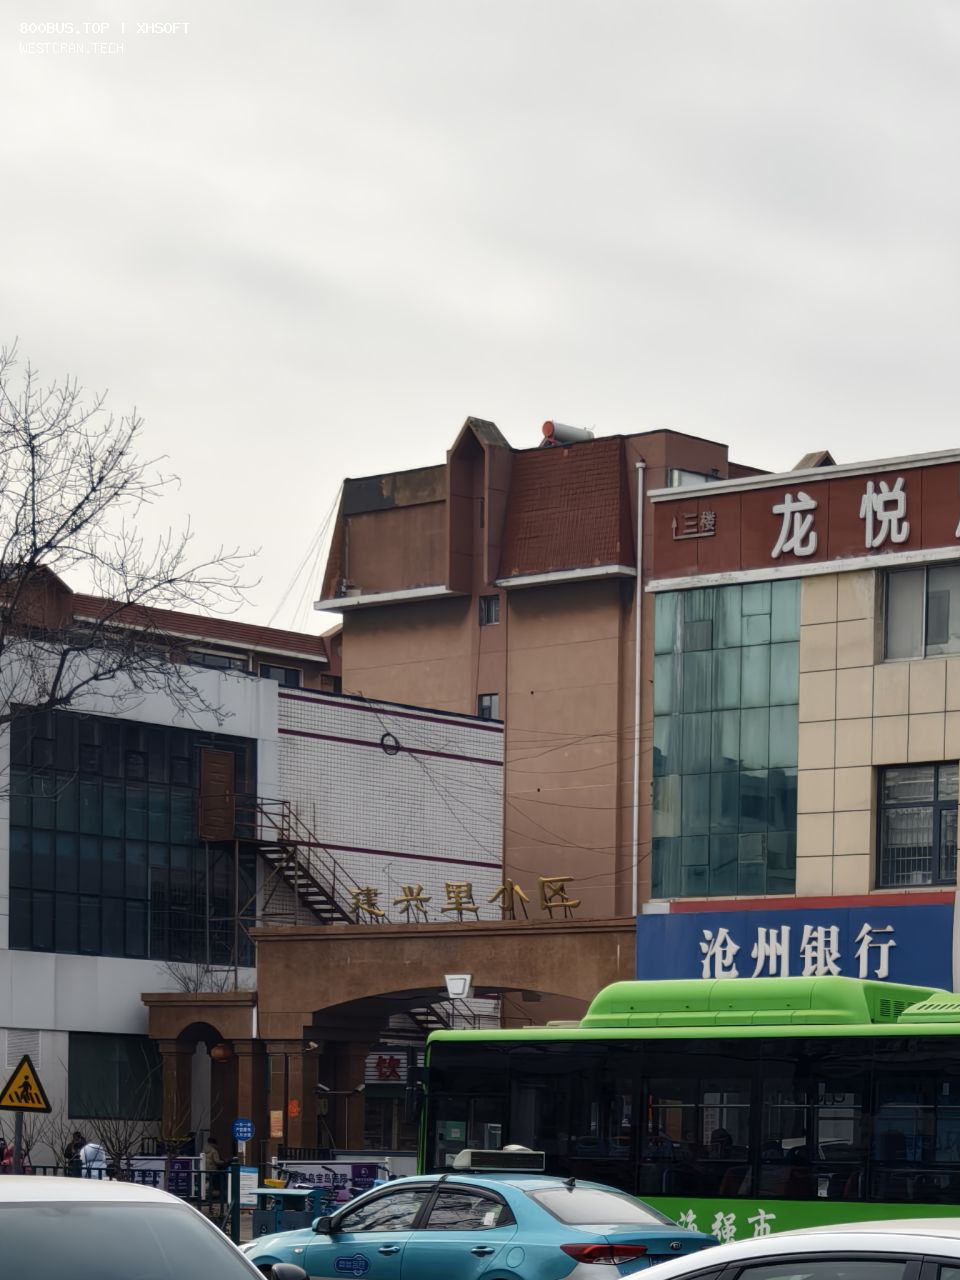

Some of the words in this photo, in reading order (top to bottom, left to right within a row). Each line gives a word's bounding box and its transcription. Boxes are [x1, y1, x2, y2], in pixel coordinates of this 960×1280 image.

[681, 511, 716, 534] 三楼
[699, 924, 898, 979] 沧州银行
